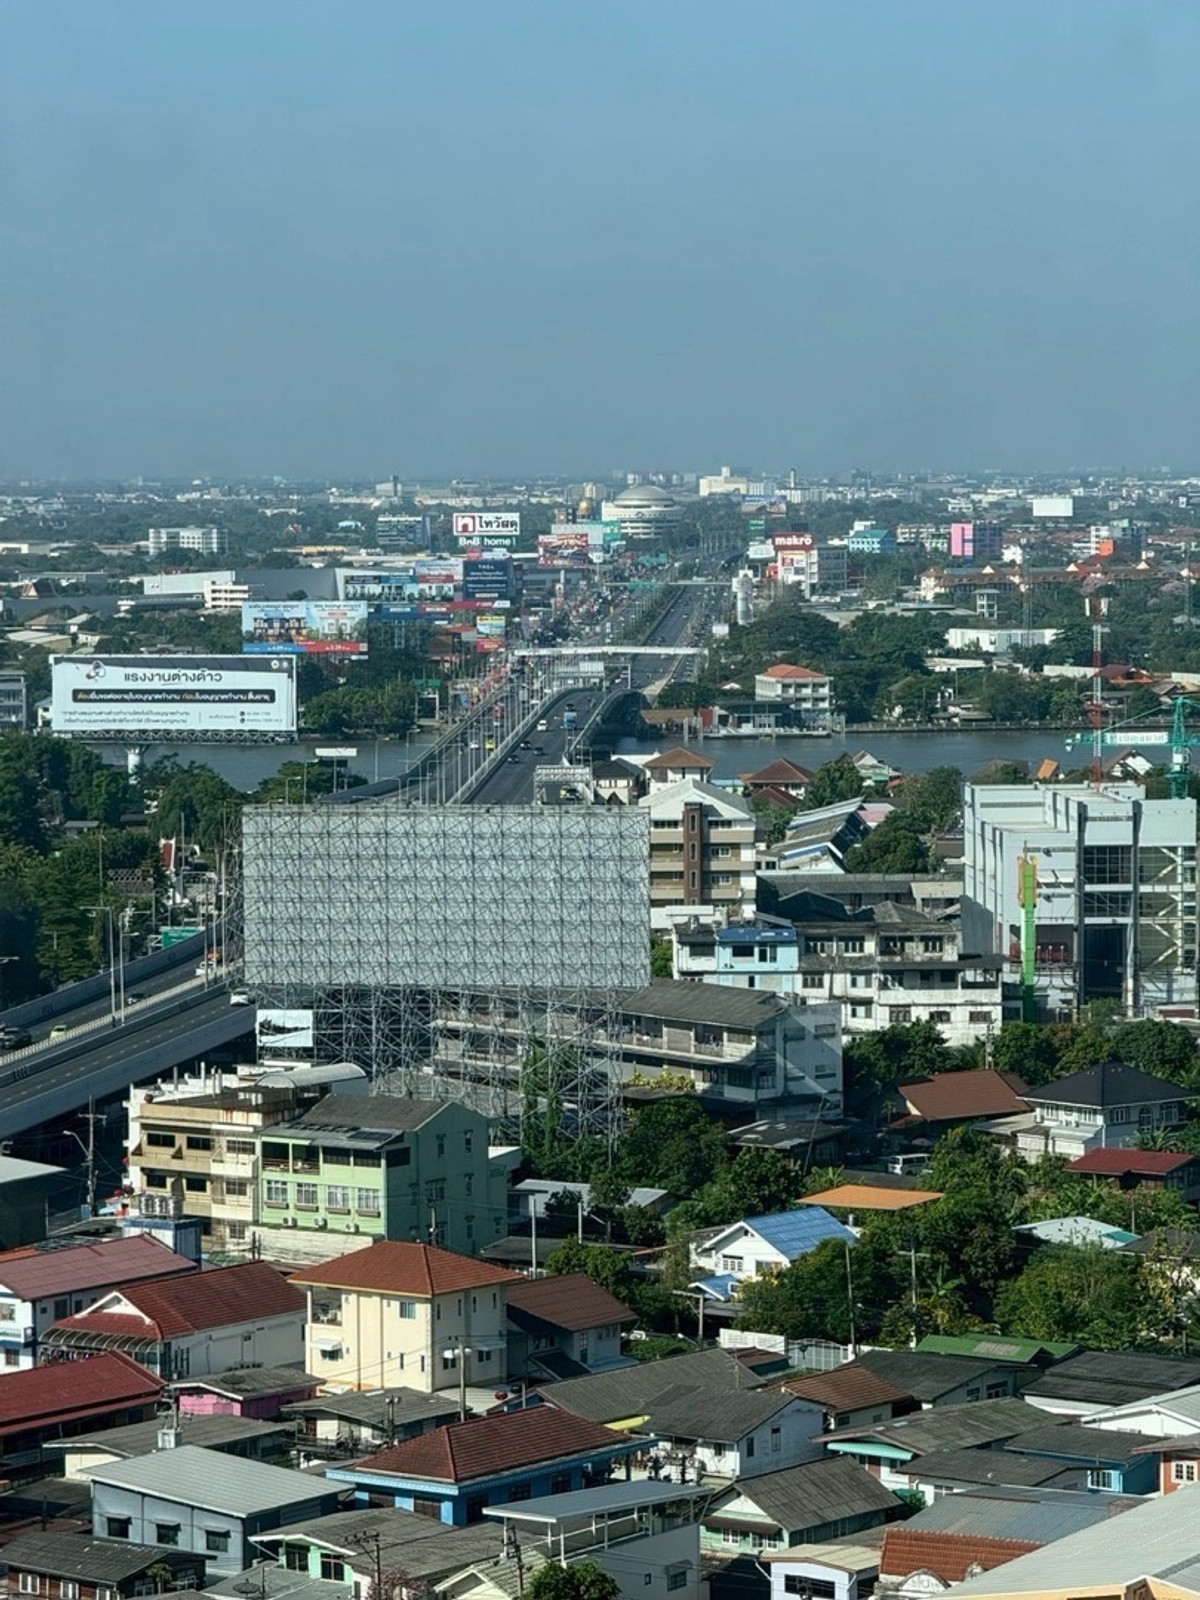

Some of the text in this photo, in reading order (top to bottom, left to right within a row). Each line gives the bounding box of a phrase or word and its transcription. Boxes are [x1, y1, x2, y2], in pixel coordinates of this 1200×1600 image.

[477, 515, 518, 532] ไทวัสดุ
[484, 537, 511, 546] home
[124, 668, 223, 682] แรงงานต่างด้าว
